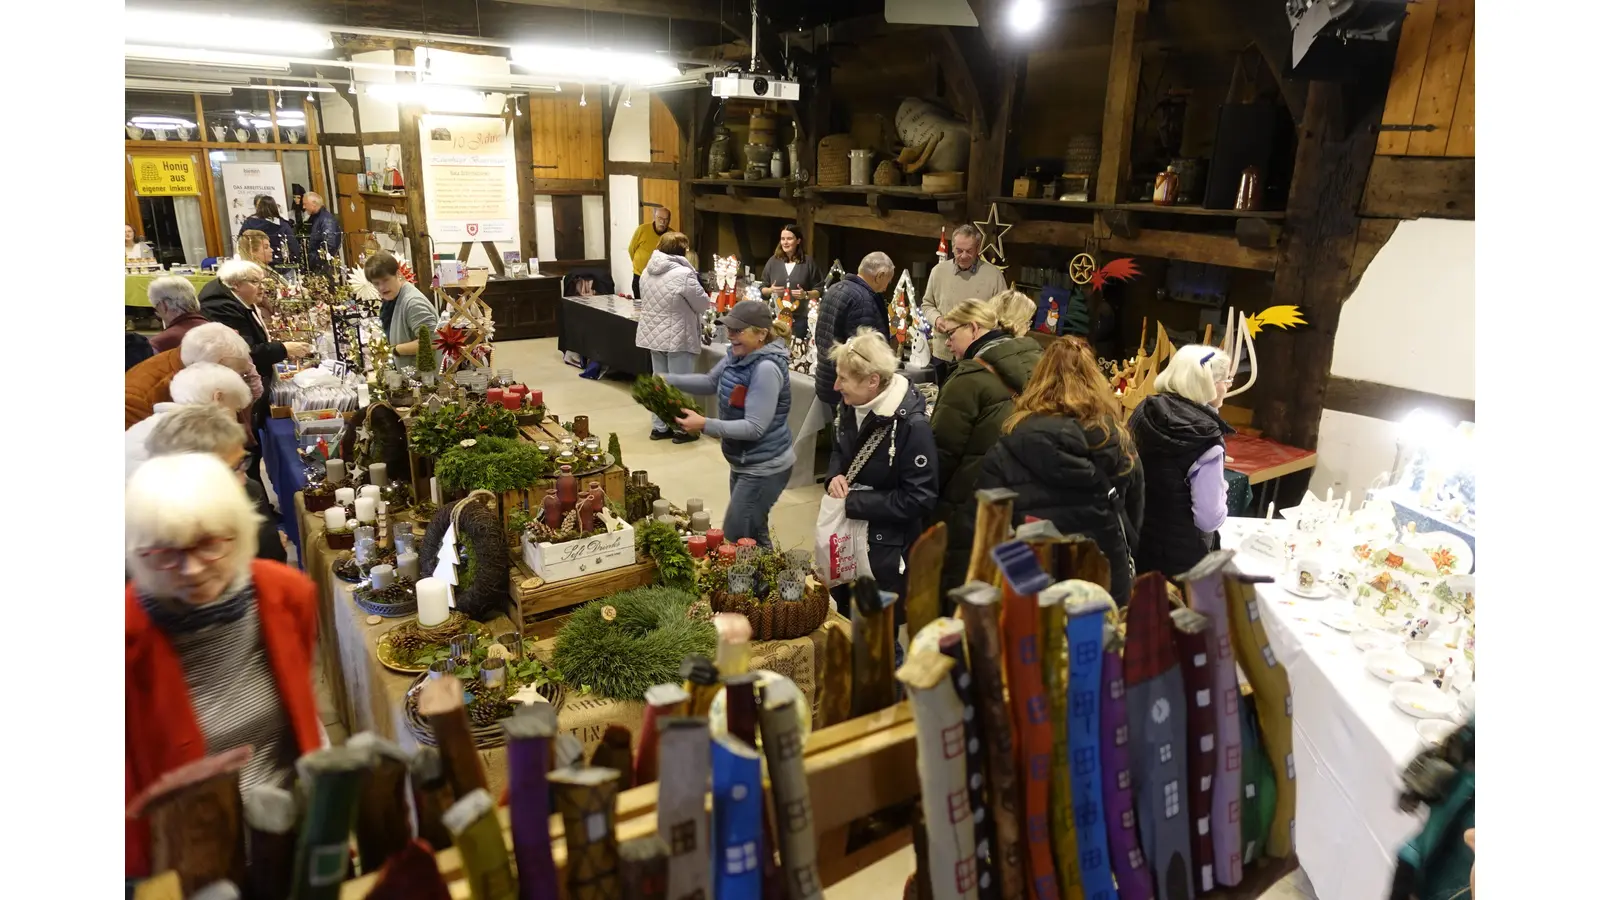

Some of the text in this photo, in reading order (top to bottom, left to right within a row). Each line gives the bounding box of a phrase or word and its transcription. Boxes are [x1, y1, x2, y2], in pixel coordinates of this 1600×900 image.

[162, 161, 189, 173] Honig
[170, 174, 186, 182] aus
[561, 537, 621, 561] Soft Drinks
